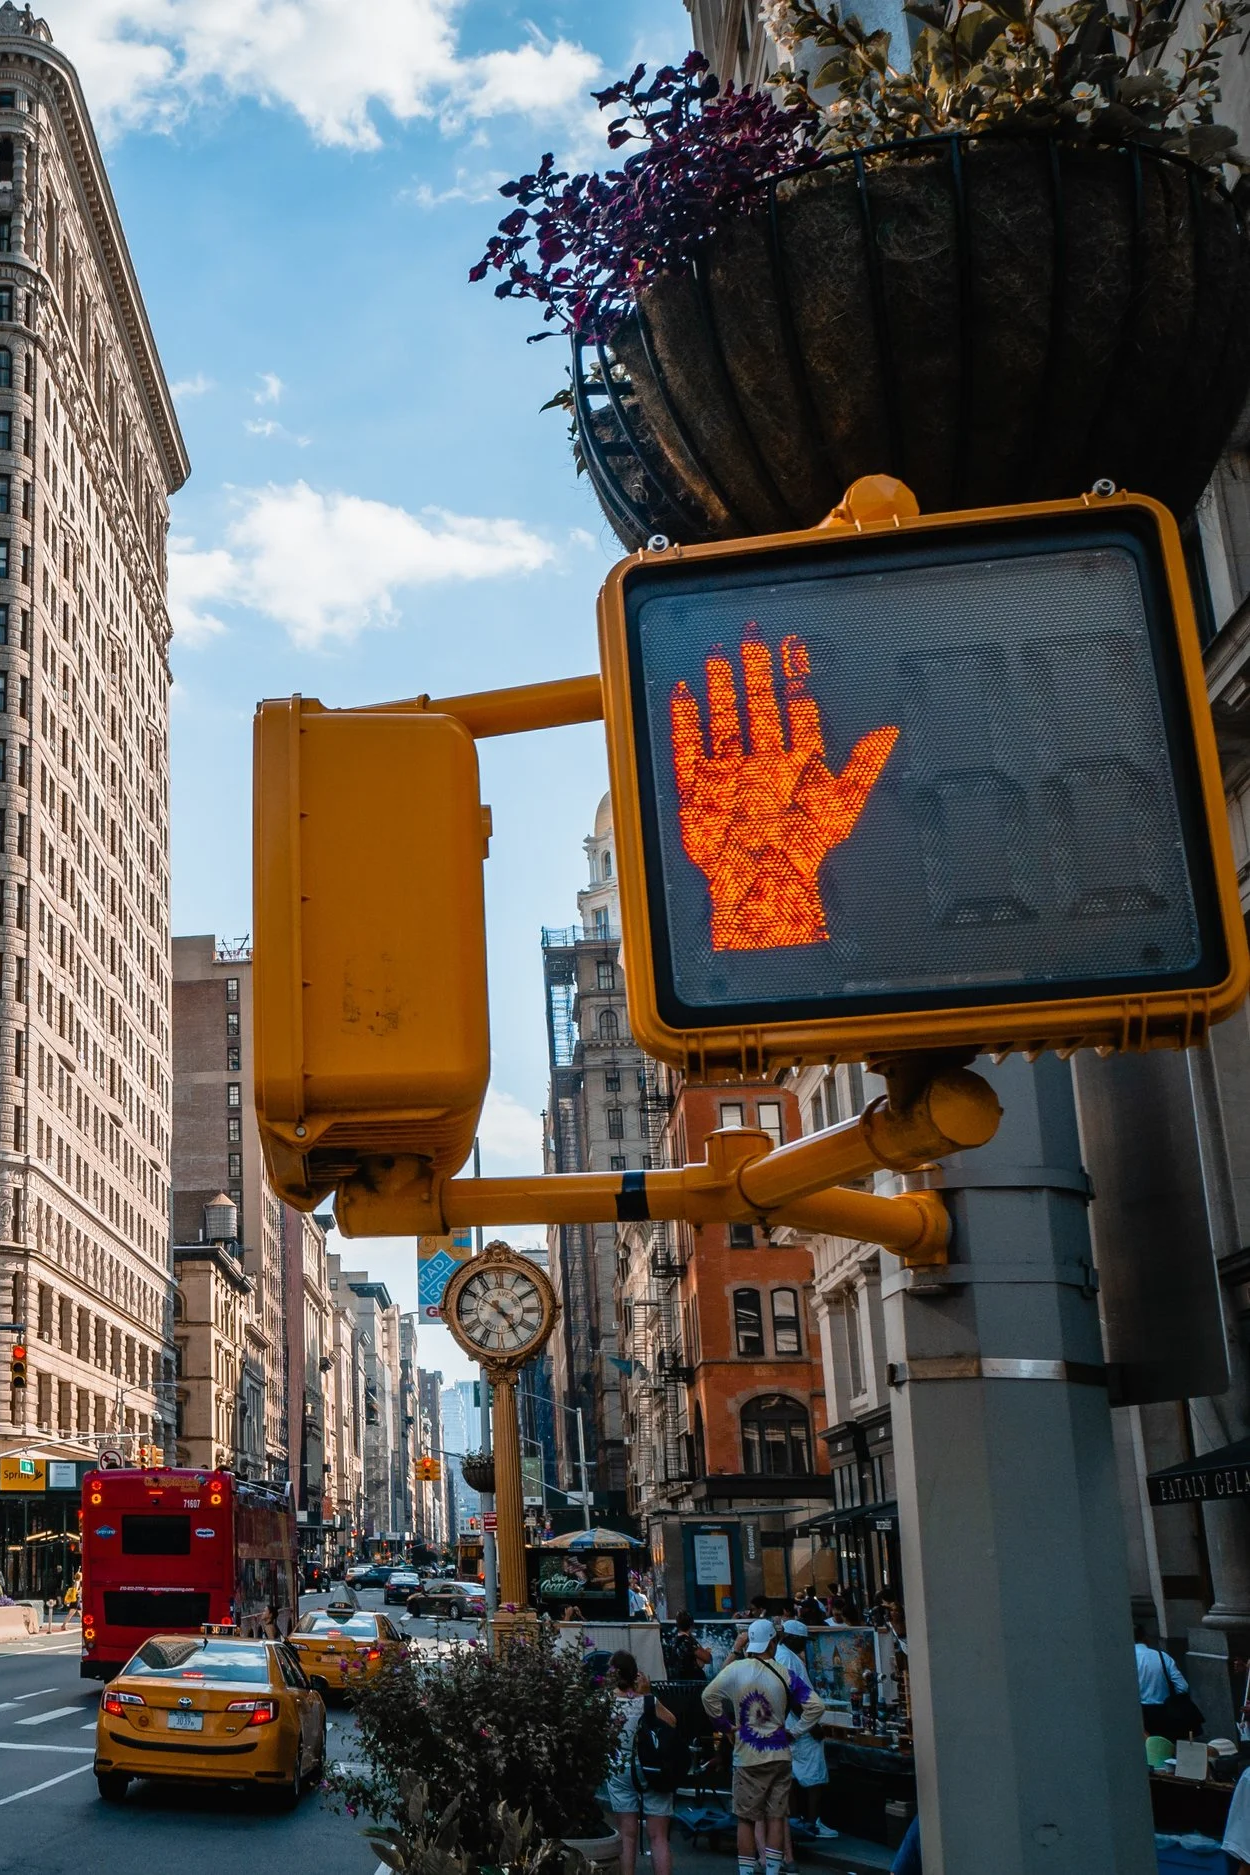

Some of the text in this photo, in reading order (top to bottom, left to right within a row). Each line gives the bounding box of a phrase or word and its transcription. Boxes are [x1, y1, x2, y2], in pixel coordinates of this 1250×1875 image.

[419, 1257, 449, 1287] MAD.
[497, 1290, 521, 1309] AVENUE
[3, 1469, 31, 1481] Sprint
[1159, 1475, 1207, 1501] EATALY
[183, 1499, 201, 1509] 71607
